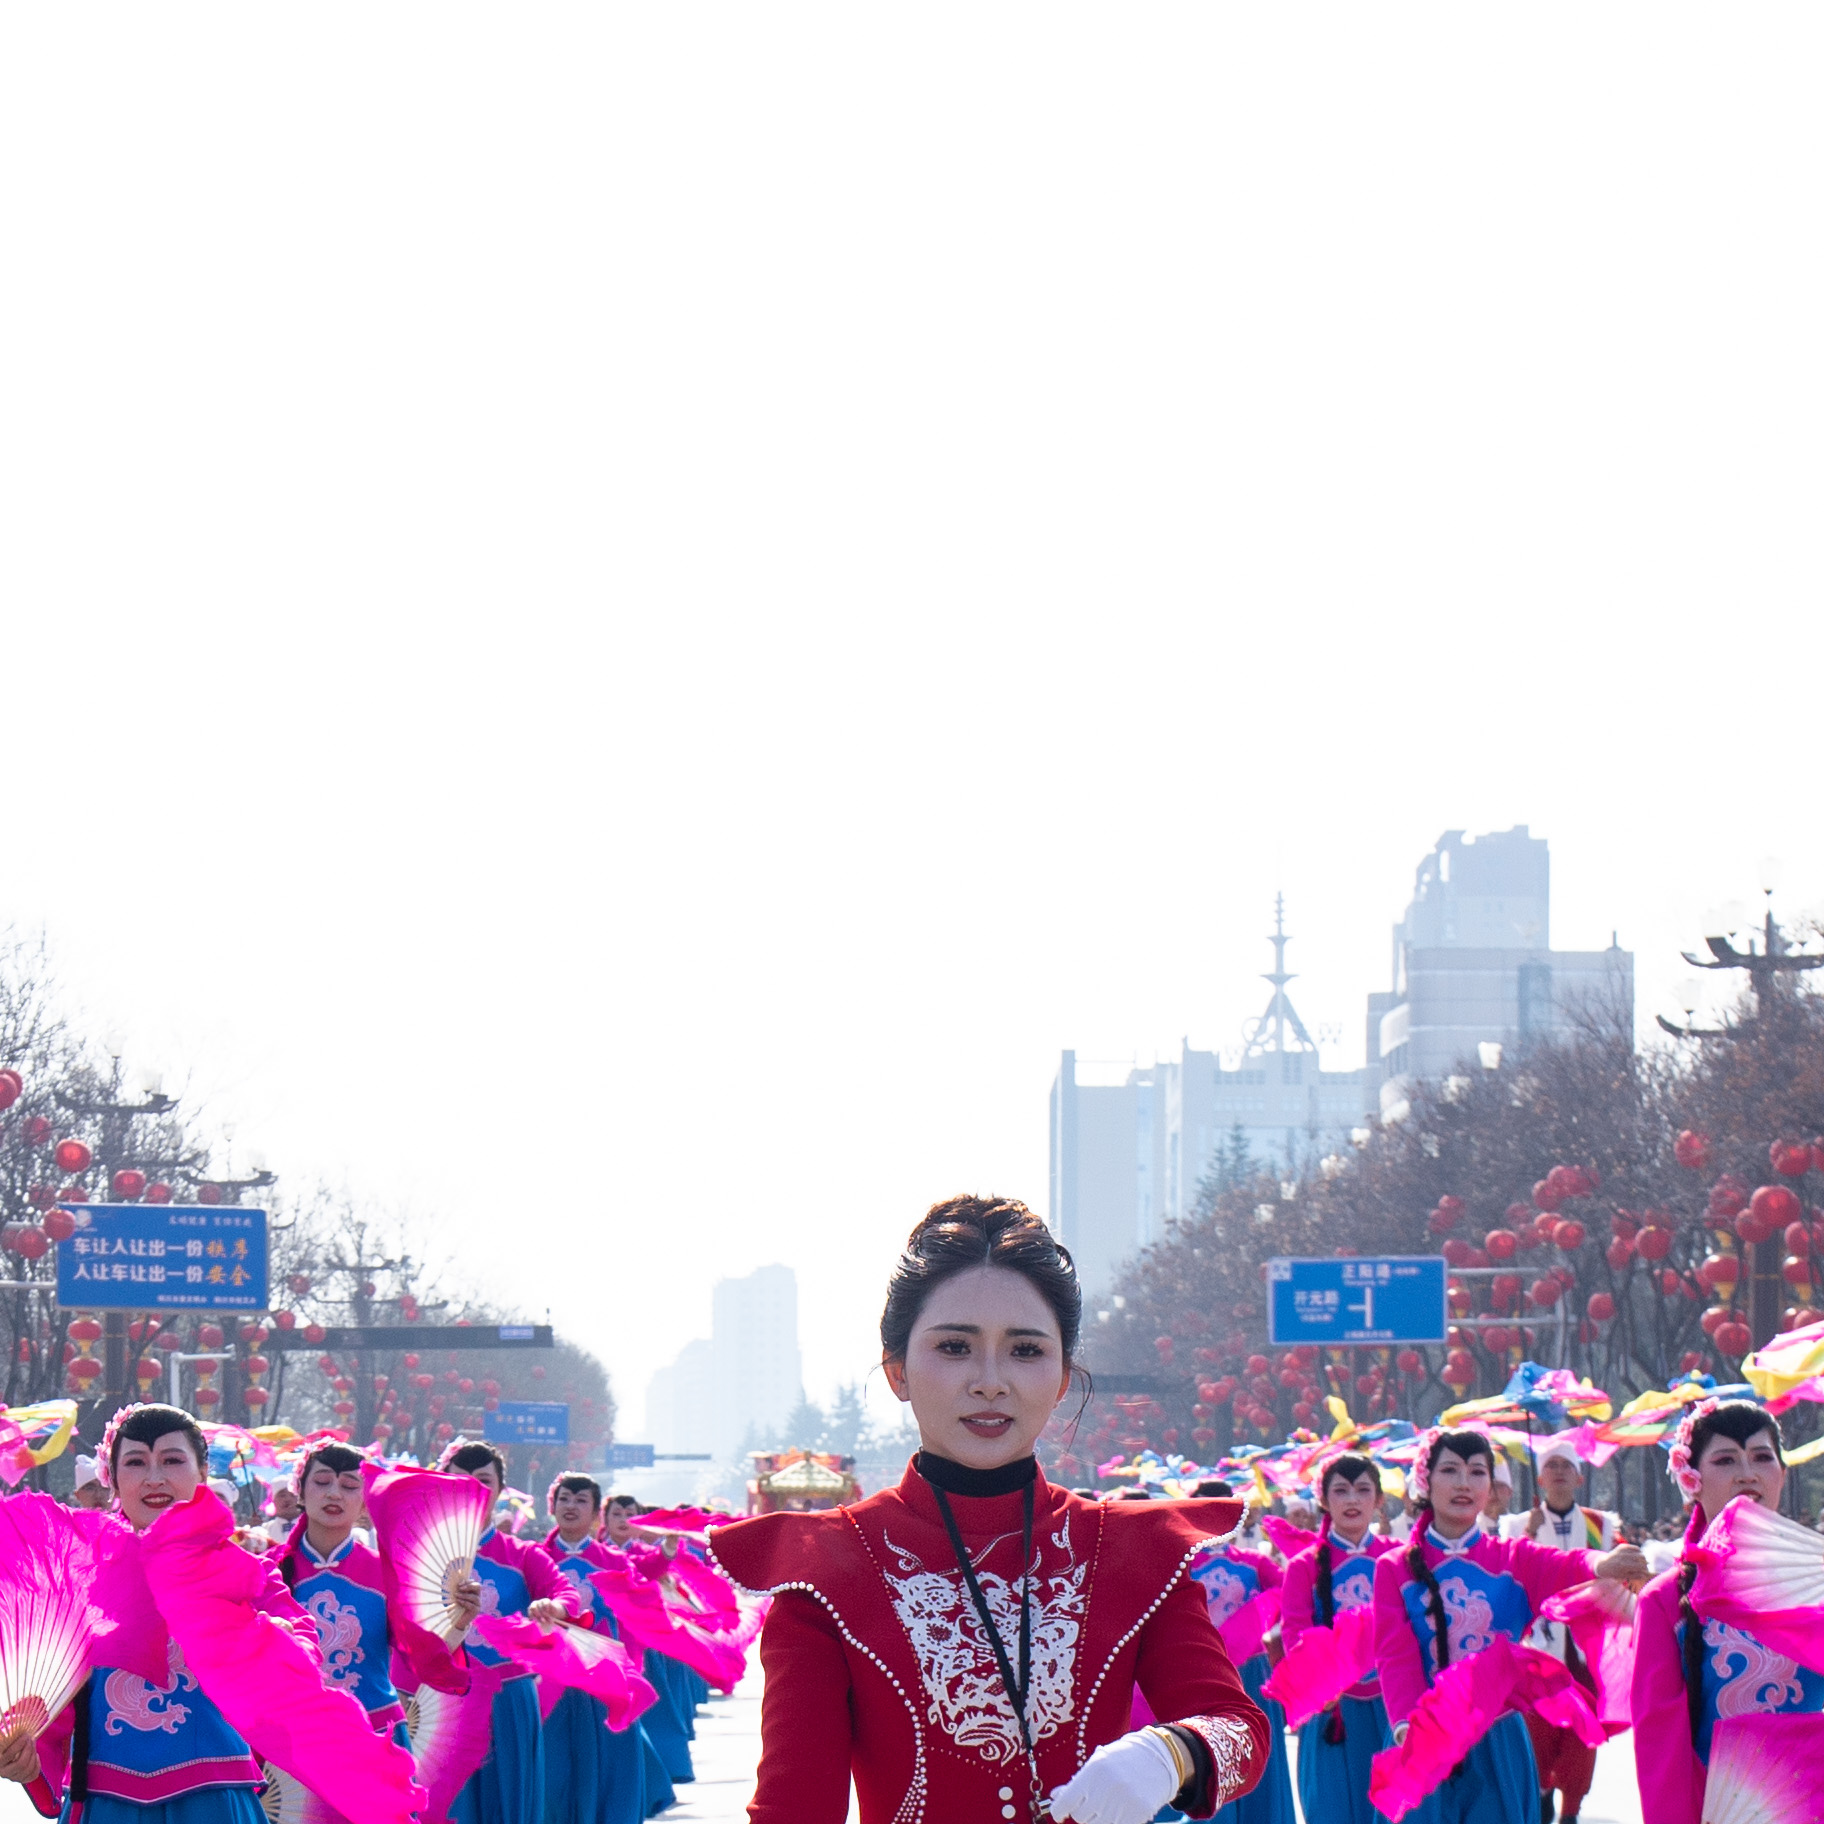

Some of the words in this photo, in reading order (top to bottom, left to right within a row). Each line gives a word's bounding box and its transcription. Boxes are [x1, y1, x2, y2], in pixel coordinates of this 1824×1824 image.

[73, 1237, 249, 1260] 车让人让出一份秩序
[73, 1263, 252, 1286] 人让车让出一份安全
